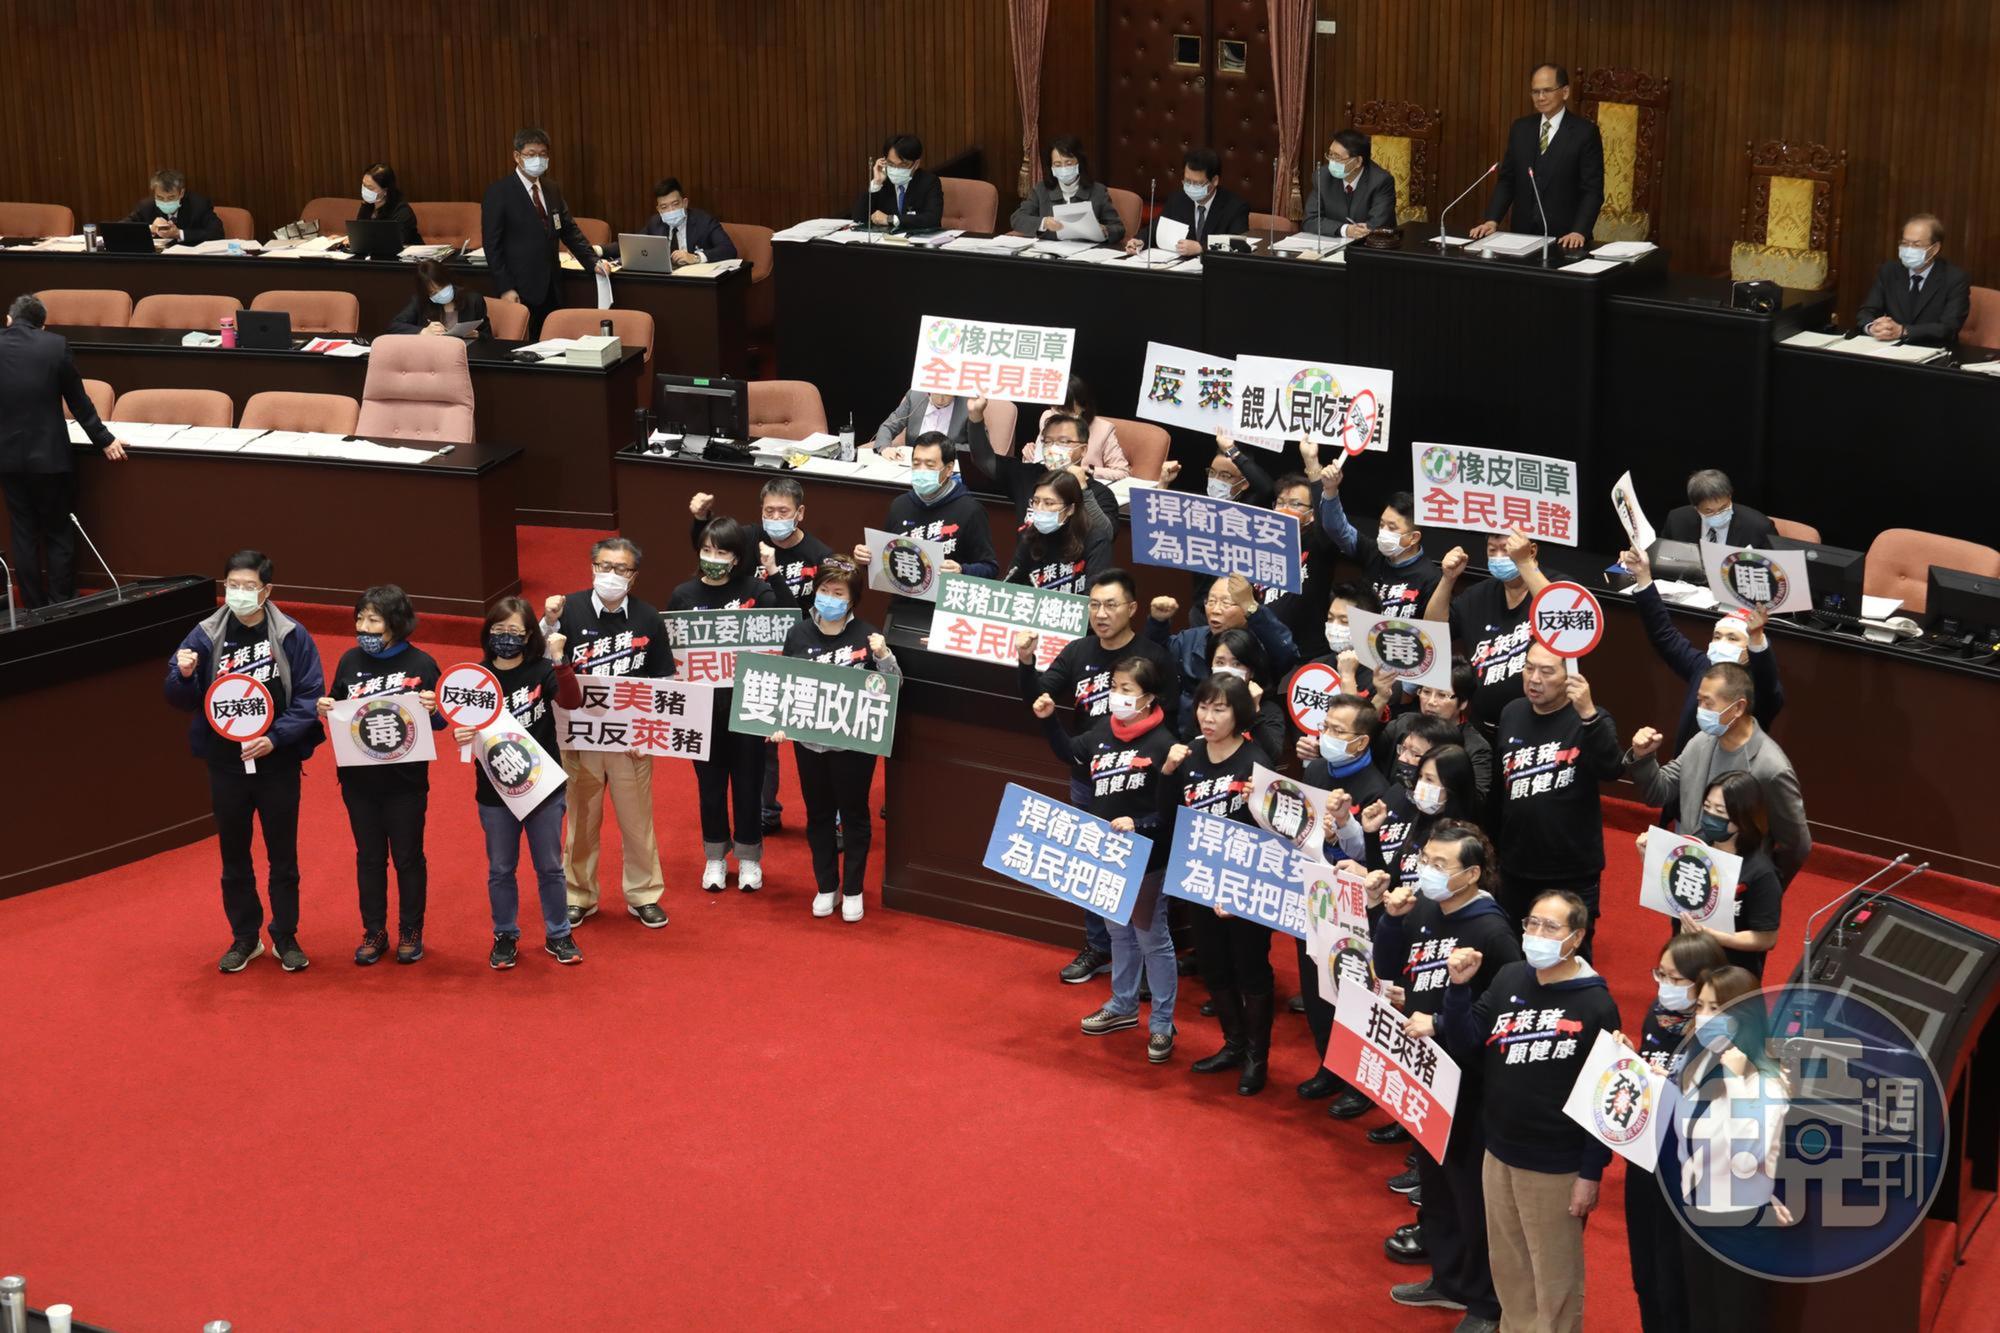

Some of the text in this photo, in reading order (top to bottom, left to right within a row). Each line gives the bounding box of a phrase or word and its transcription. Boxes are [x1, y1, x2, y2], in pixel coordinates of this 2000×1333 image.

[959, 323, 1068, 363] 橡皮圖章
[920, 357, 1064, 401] 全民見證
[1456, 451, 1571, 497] 橡皮圖章
[1146, 493, 1287, 549] 捍衛食安
[1422, 487, 1571, 540] 全民見證
[894, 551, 922, 584] 毒
[1147, 530, 1288, 587] 為民把關
[943, 577, 1085, 633] 萊豬立委/總統
[1537, 609, 1596, 631] 反萊豬
[571, 631, 633, 662] 反萊豬
[1382, 633, 1419, 666] 毒
[212, 697, 267, 719] 反萊豬
[442, 685, 496, 710] 反萊豬
[582, 680, 687, 717] 反美豬
[739, 668, 891, 743] 雙標政府
[364, 712, 402, 749] 毒
[564, 718, 703, 754] 只反萊豬
[1094, 771, 1147, 798] 顧健康
[1510, 765, 1577, 800] 顧健康
[1016, 796, 1134, 870] 捍衛食安
[1001, 833, 1128, 913] 為民把關
[1674, 860, 1707, 906] 毒
[1180, 859, 1307, 934] 為民把關
[1412, 968, 1451, 992] 顧健
[1491, 1007, 1566, 1035] 反萊豬
[1505, 1038, 1578, 1065] 顧健康
[1355, 1045, 1430, 1134] 護食安
